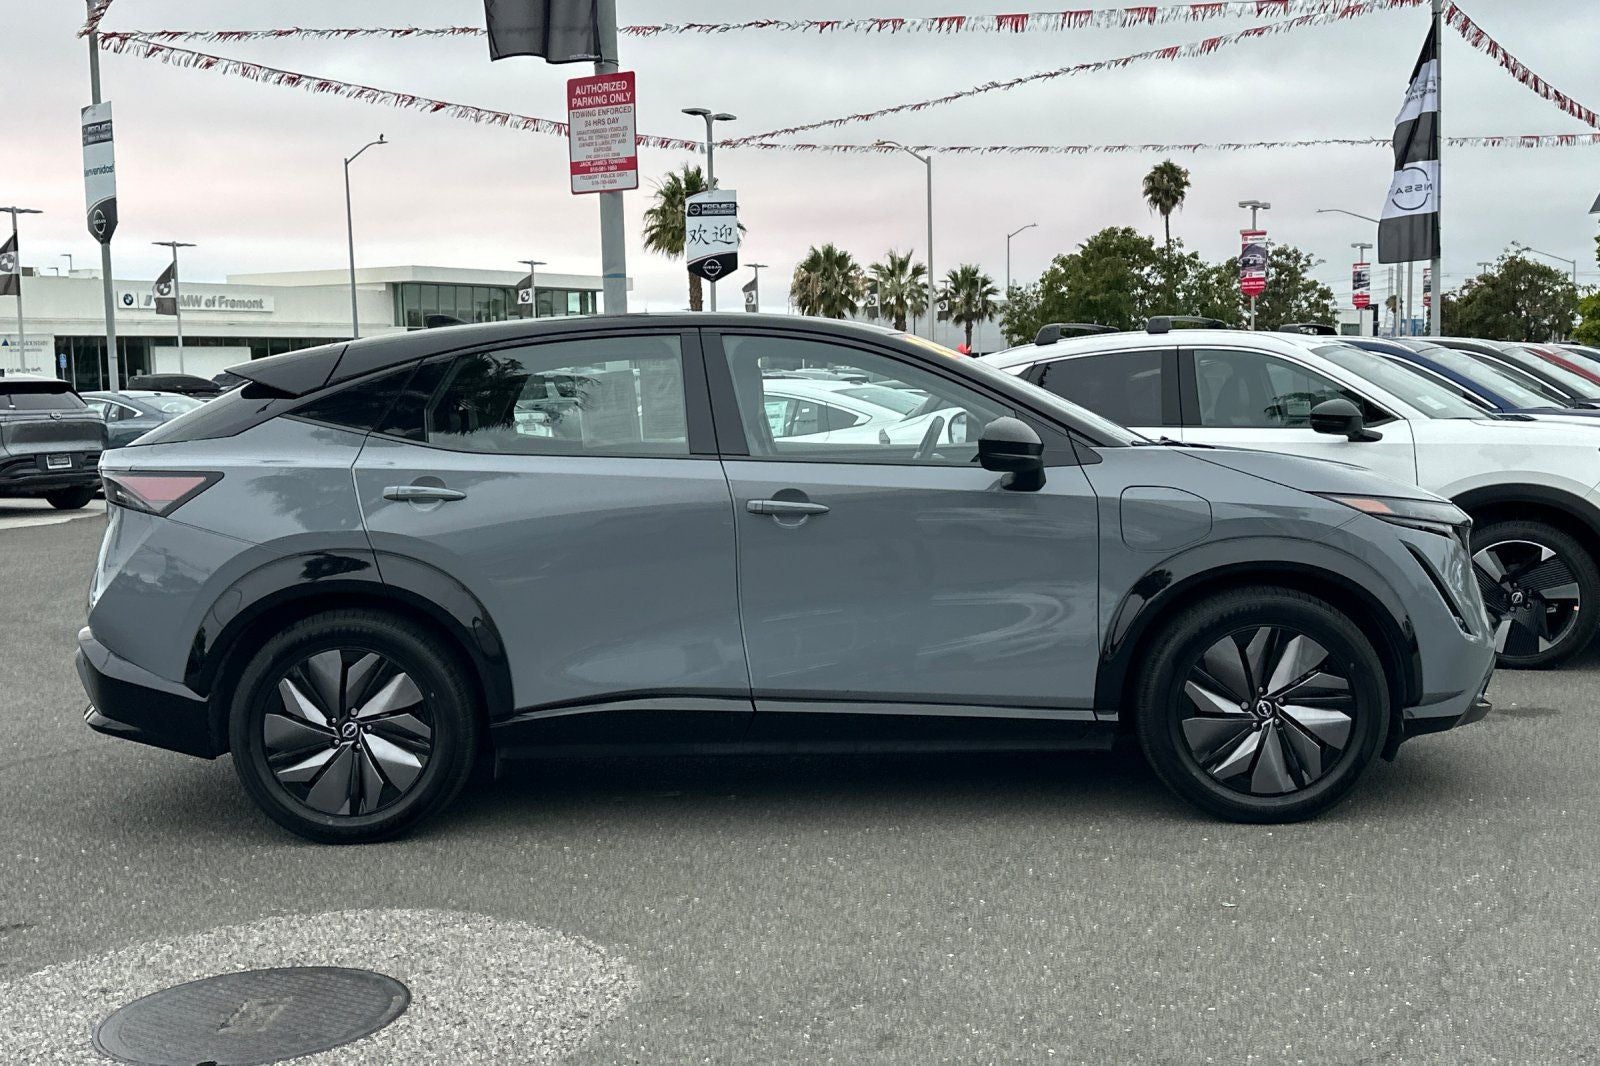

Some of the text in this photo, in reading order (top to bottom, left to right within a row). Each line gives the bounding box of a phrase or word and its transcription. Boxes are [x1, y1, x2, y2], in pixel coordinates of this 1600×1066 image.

[575, 80, 628, 95] AUTHORIZED
[572, 92, 632, 108] PARKING ONLY
[572, 106, 632, 119] TOWING ENFORCED
[592, 118, 606, 127] HRS
[607, 116, 620, 125] DAY
[688, 224, 735, 245] 欢迎
[178, 295, 264, 309] MW of Fremont
